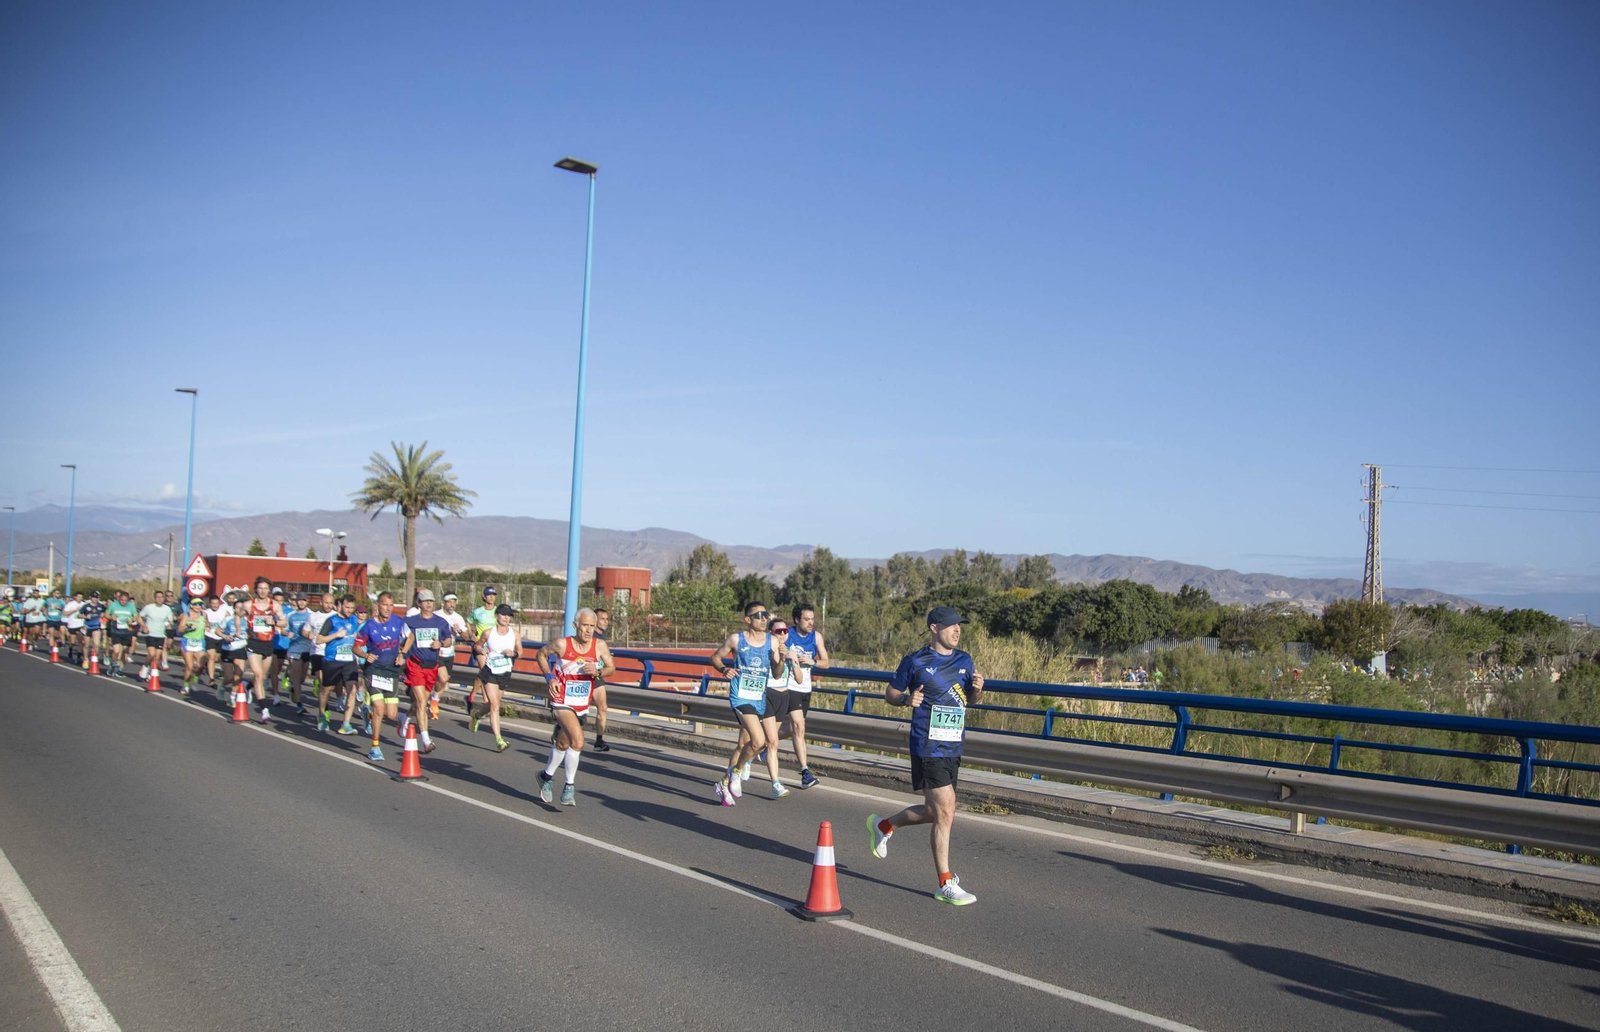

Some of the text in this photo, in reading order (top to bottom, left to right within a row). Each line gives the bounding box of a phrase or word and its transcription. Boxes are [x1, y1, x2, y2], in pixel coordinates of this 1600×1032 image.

[190, 583, 204, 591] 30
[744, 679, 763, 688] 1245
[936, 713, 962, 725] 1747
